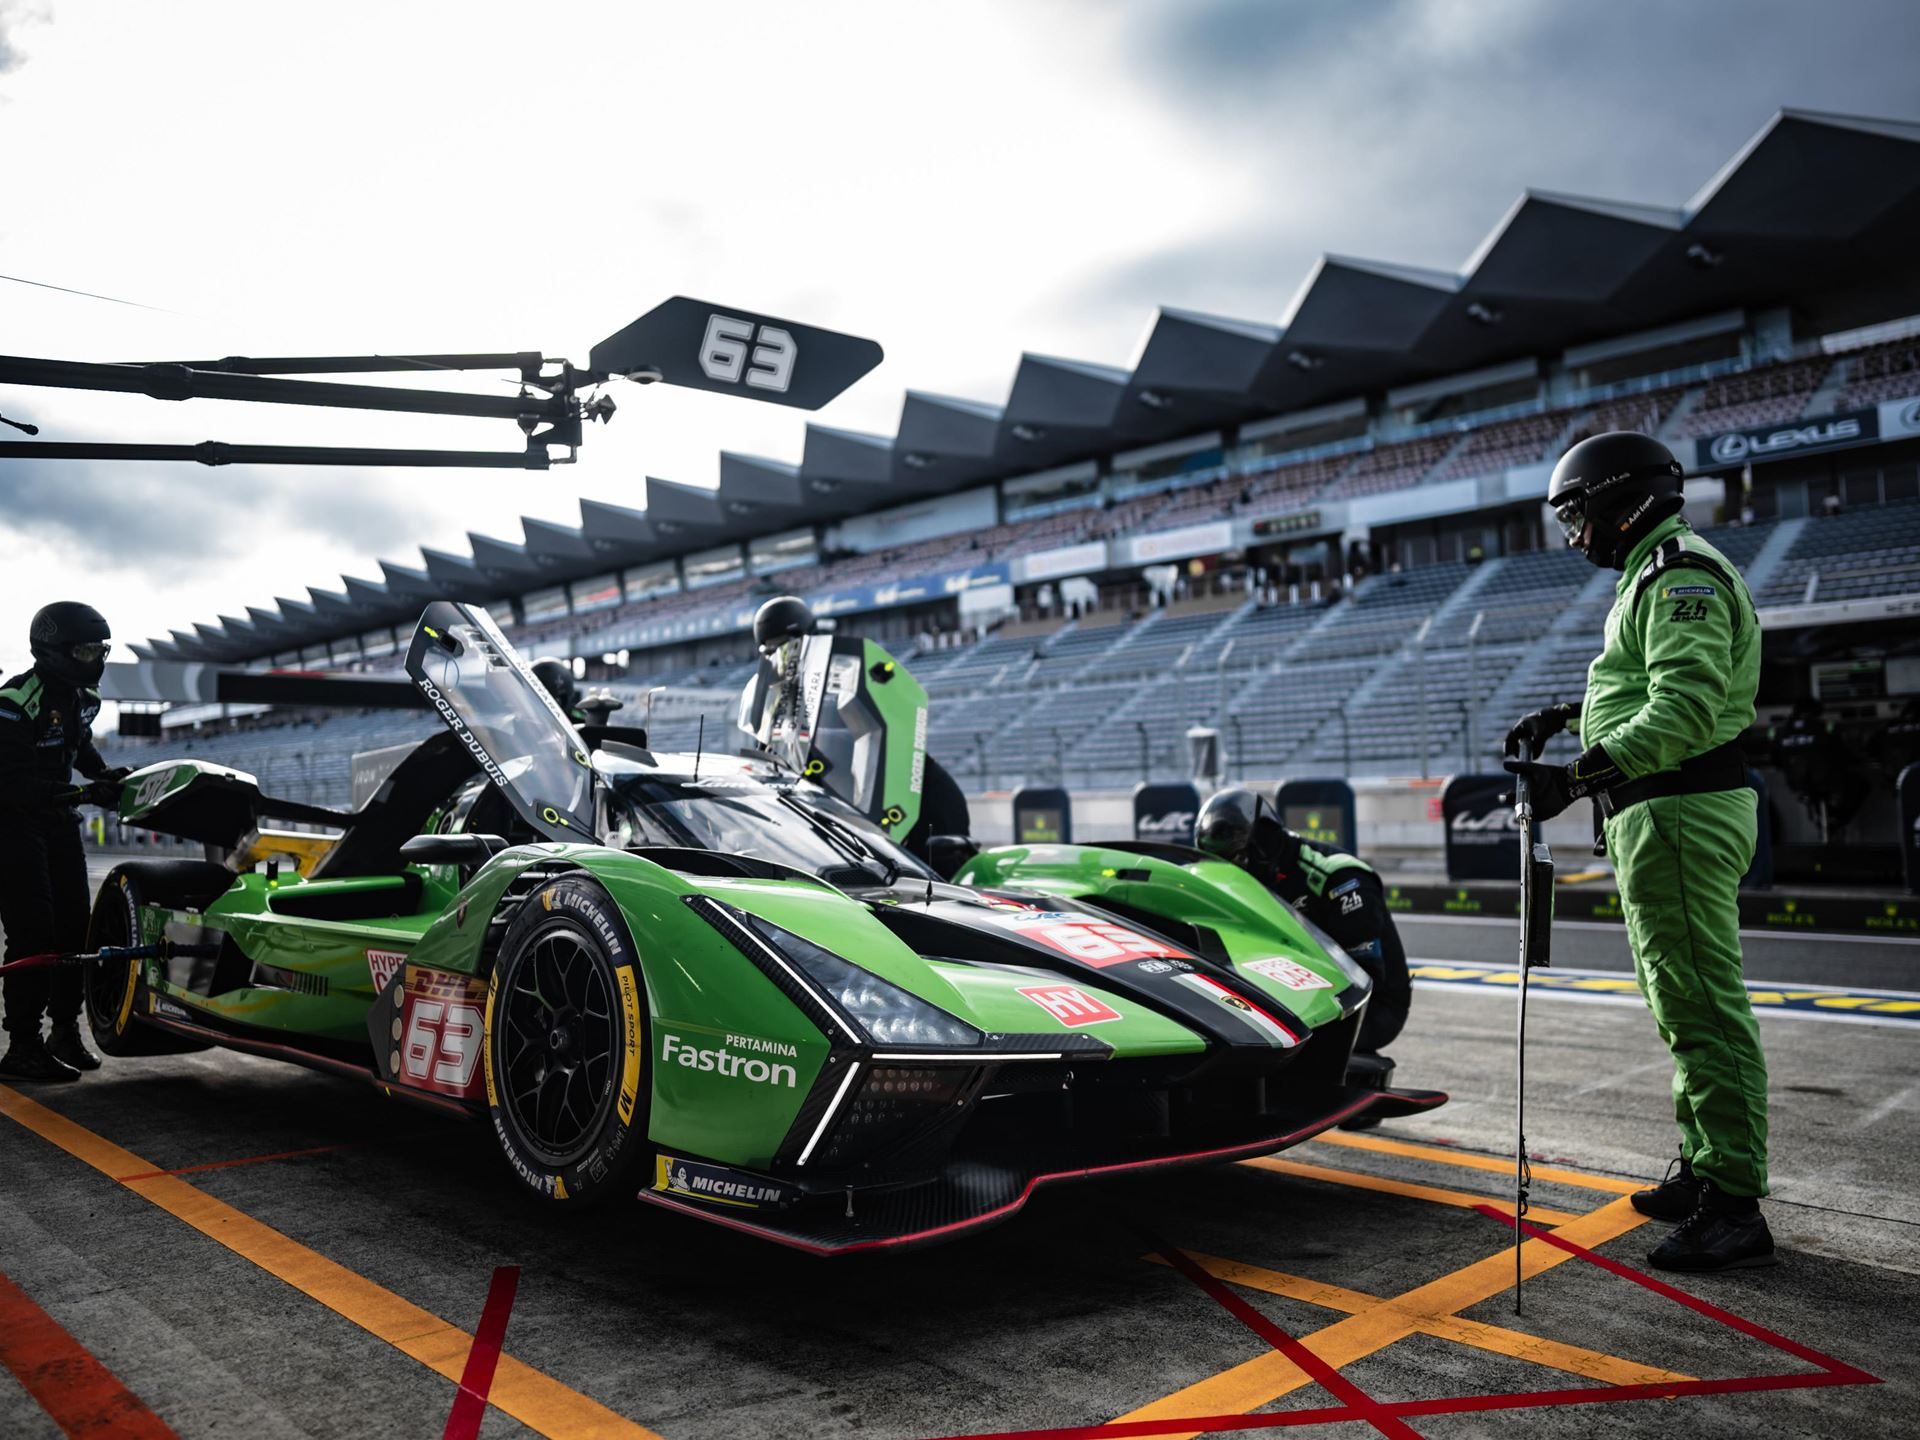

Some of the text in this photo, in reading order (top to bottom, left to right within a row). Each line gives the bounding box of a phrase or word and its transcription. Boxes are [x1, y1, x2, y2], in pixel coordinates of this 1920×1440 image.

[700, 315, 796, 391] 63
[1751, 418, 1861, 453] LEXUS
[1672, 600, 1708, 616] 24h
[418, 678, 509, 787] ROGER DUBUIS
[564, 892, 622, 956] MICHELIN
[413, 969, 478, 1000] DHL
[1031, 987, 1101, 1018] HY
[404, 998, 485, 1088] 63
[621, 975, 637, 1057] PILOT SPORT
[661, 1034, 796, 1088] Fastron
[726, 1034, 798, 1058] PERTAMINA
[493, 1117, 543, 1191] MICHELIN
[692, 1175, 781, 1202] MICHELIN
